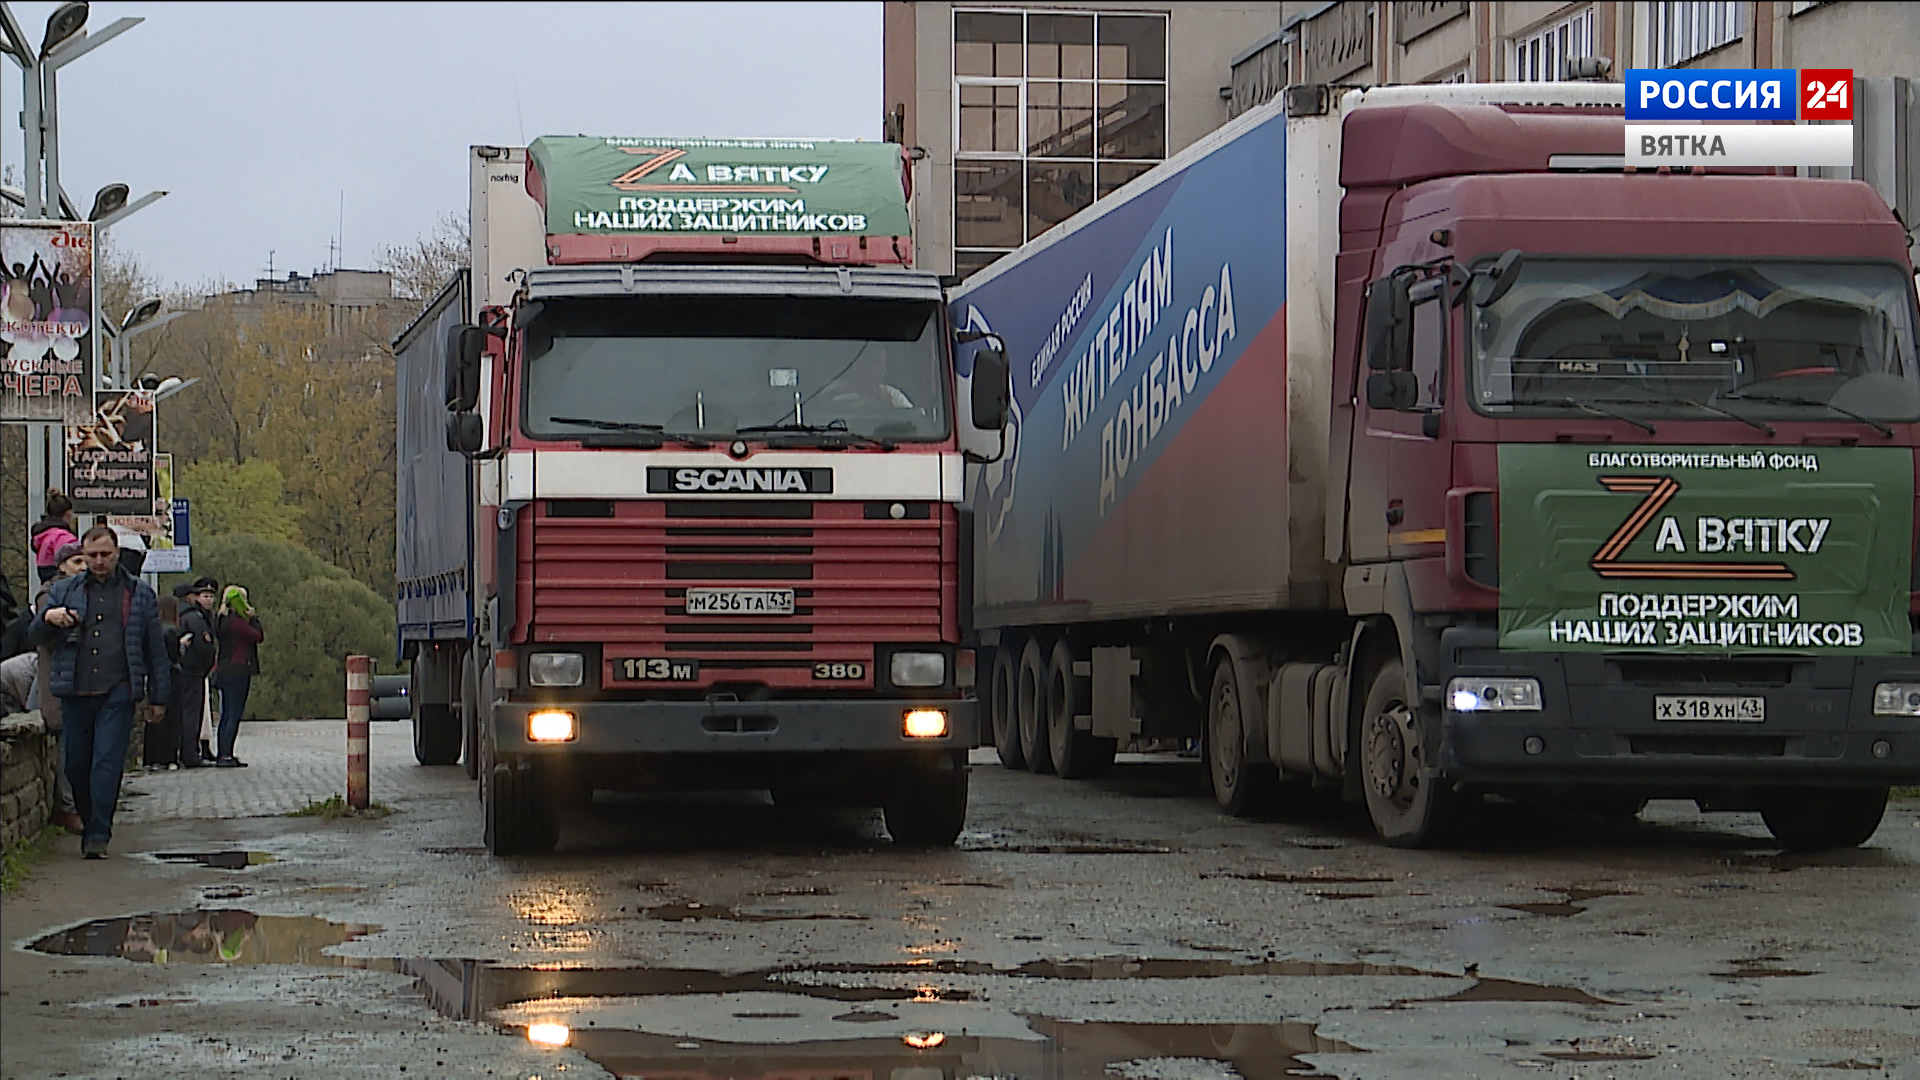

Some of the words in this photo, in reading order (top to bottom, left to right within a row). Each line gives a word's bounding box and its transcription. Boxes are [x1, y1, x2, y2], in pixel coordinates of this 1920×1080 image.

[707, 165, 829, 183] ВЯТКУ
[620, 198, 804, 214] ПОДДЕРЖИМ
[574, 212, 673, 230] НАШИХ
[679, 213, 867, 231] ЗАЩИТНИКОВ
[1031, 322, 1060, 388] ЕДИНАЯ
[1062, 272, 1092, 343] РОССИЯ
[1062, 226, 1173, 451] ЖИТЕЛЯМ
[1100, 262, 1236, 517] ДОНБАССА
[73, 451, 147, 463] ГАСТРОЛИ
[1588, 452, 1765, 470] БЛАГОТВОРИТЕЛЬНЫЙ
[1769, 453, 1818, 471] ФОНД
[675, 468, 807, 492] SCANIA
[74, 487, 147, 498] СПЕКТАКЛИ
[1698, 518, 1831, 553] ВЯТКУ
[1600, 593, 1798, 620] ПОДДЕРЖИМ
[1550, 621, 1657, 645] НАШИХ
[1665, 622, 1864, 648] ЗАЩИТНИКОВ
[814, 663, 863, 679] 380
